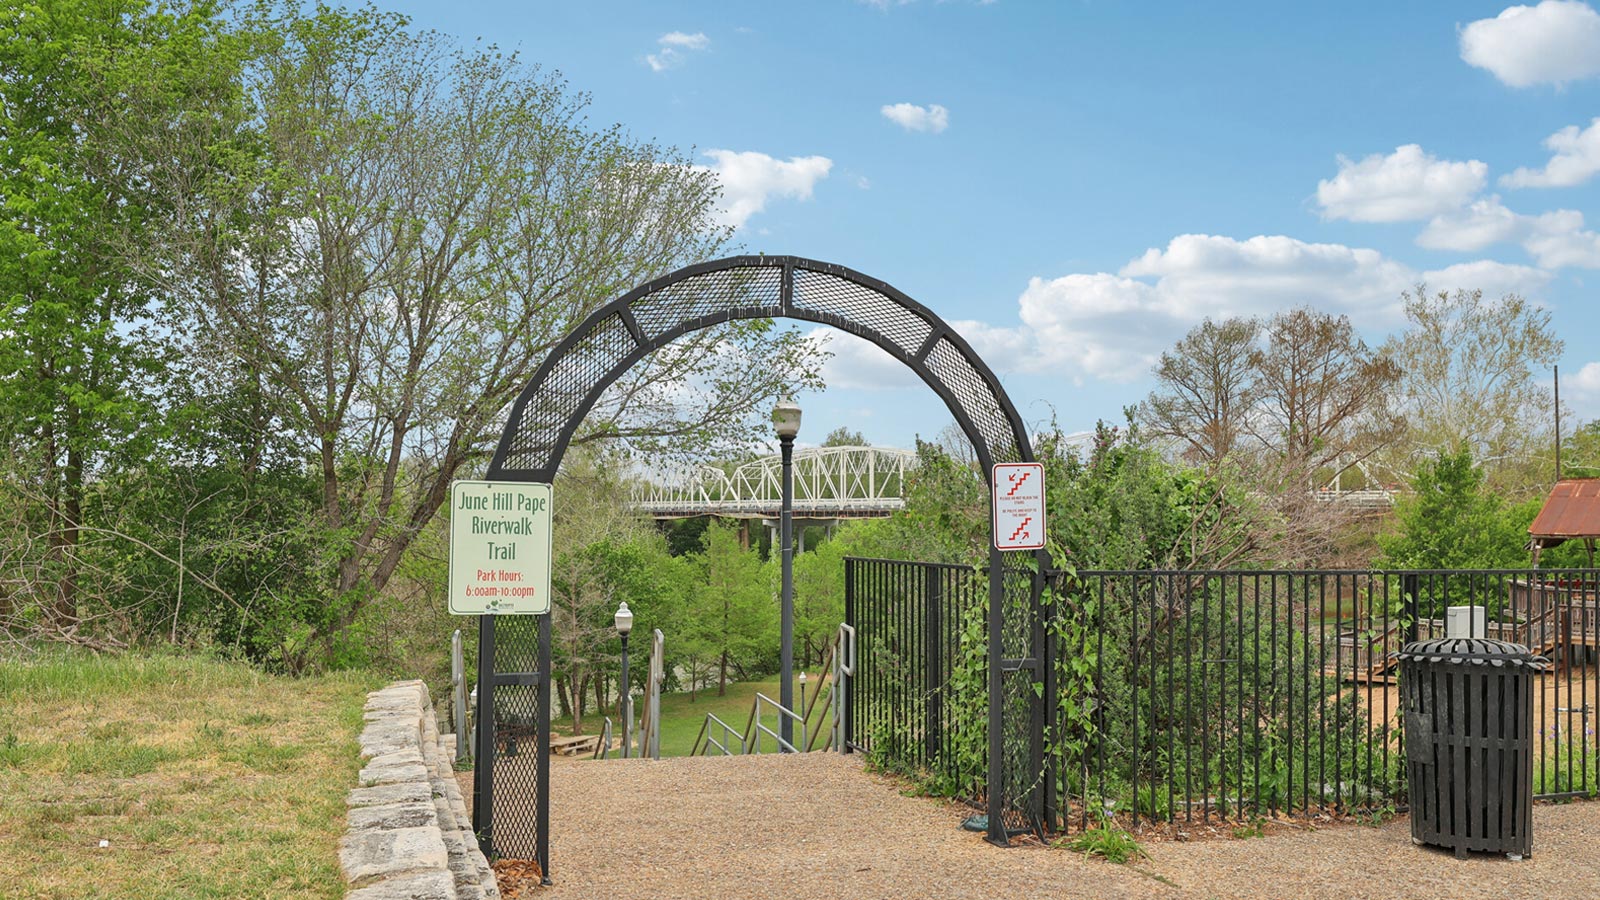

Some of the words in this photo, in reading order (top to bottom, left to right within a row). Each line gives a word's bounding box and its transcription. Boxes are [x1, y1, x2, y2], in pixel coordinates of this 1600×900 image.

[458, 491, 488, 510] June
[493, 492, 513, 511] Hill
[518, 493, 546, 515] Pape
[472, 516, 532, 535] Riverwalk
[487, 542, 516, 560] Trail
[477, 569, 496, 581] Park
[499, 569, 524, 582] Hours:
[465, 585, 534, 598] 6:00am-10:00pm
